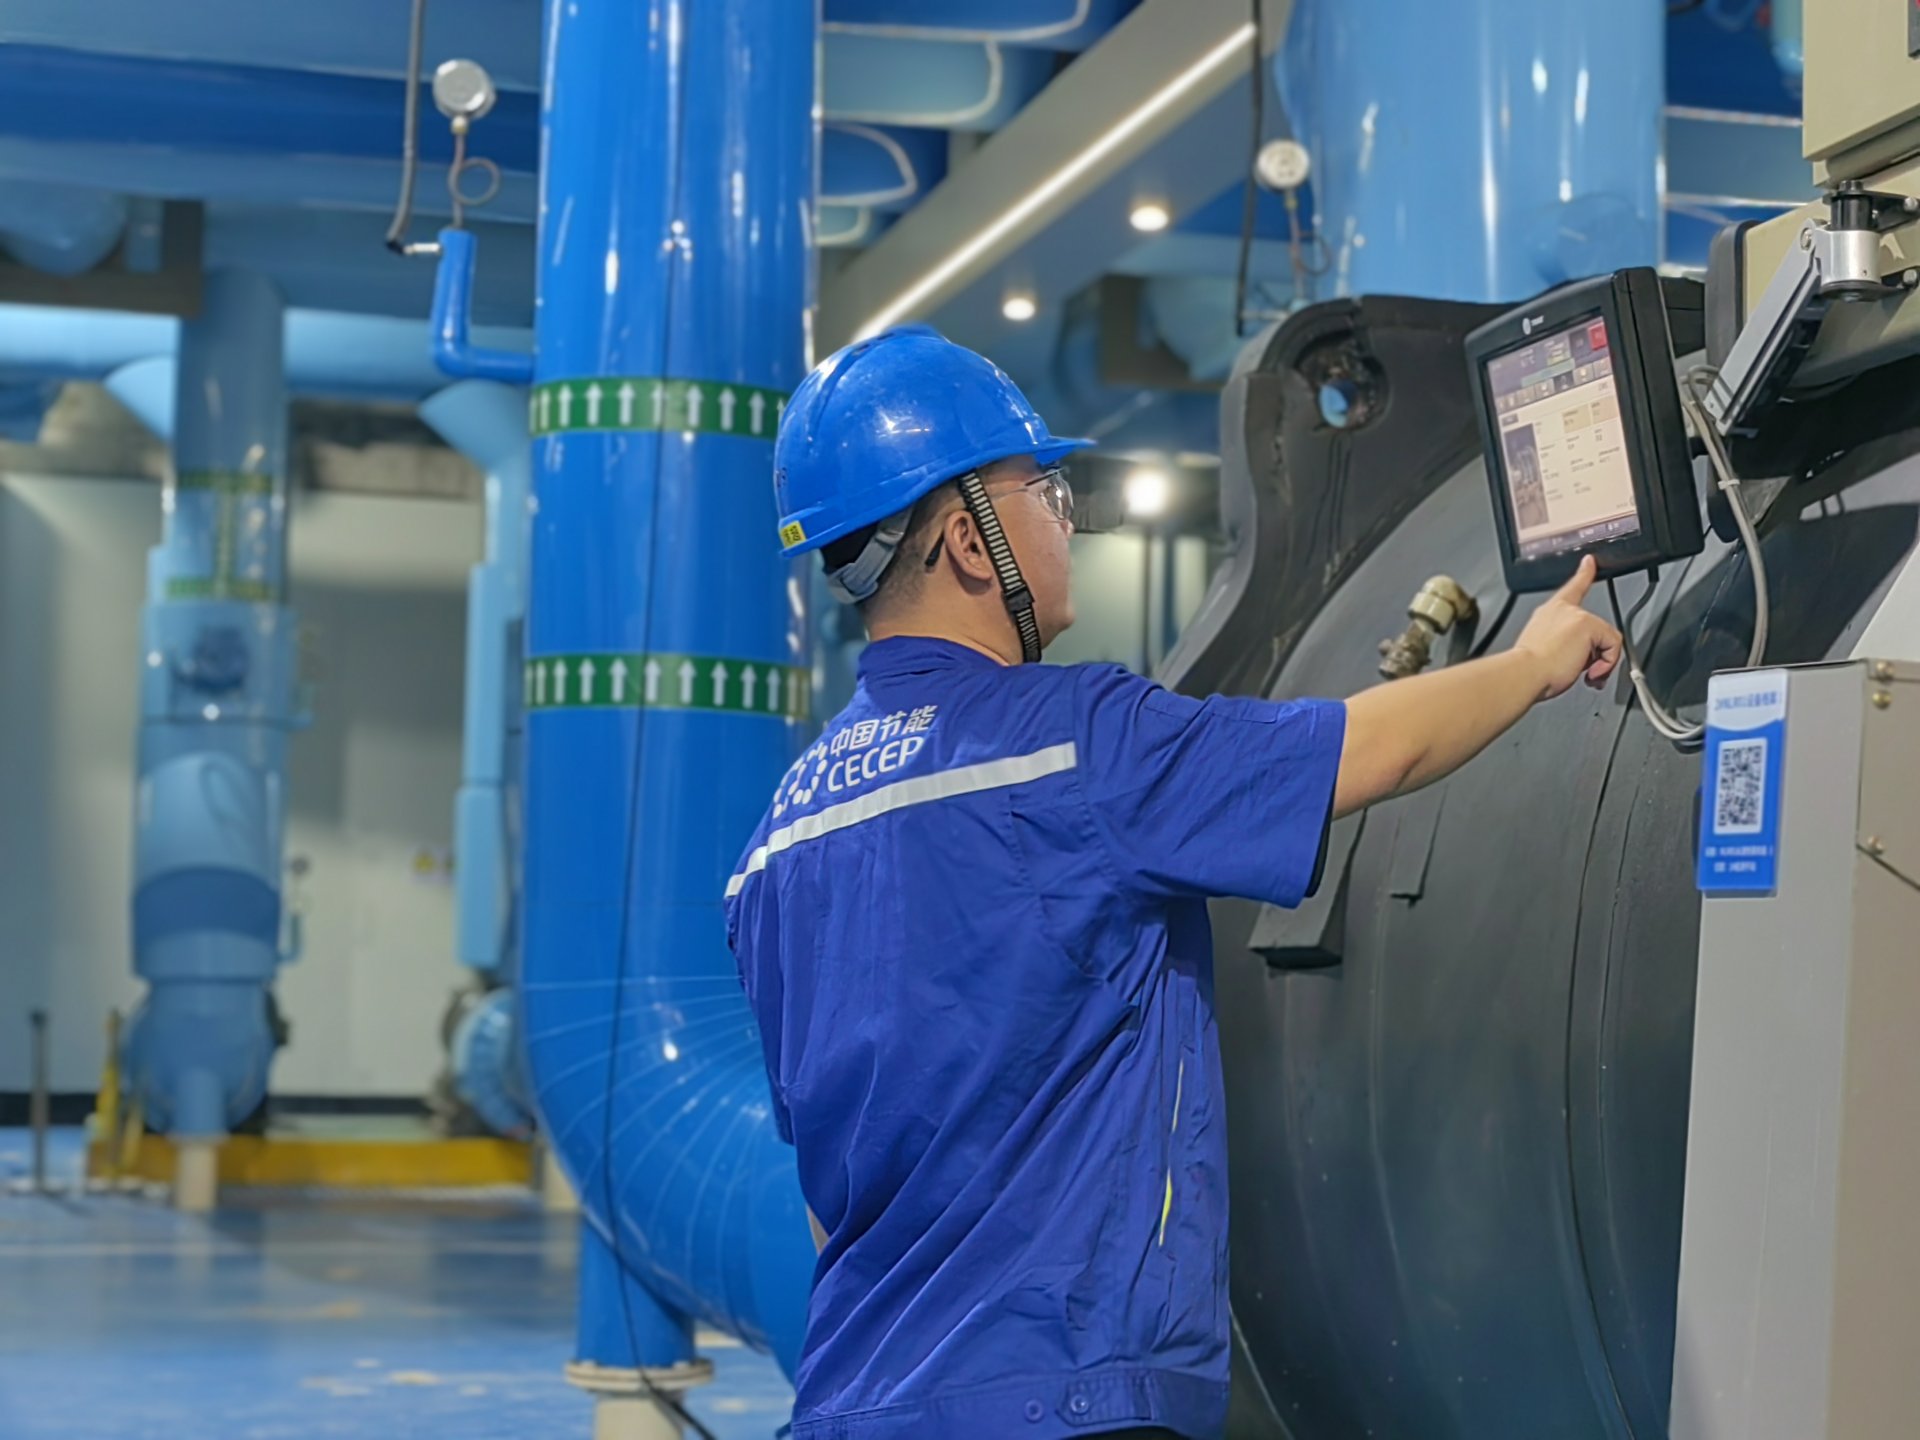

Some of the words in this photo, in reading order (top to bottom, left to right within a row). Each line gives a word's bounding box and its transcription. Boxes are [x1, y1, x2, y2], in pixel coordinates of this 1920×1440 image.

[830, 705, 938, 757] 中国节能
[827, 736, 924, 793] CECEP
